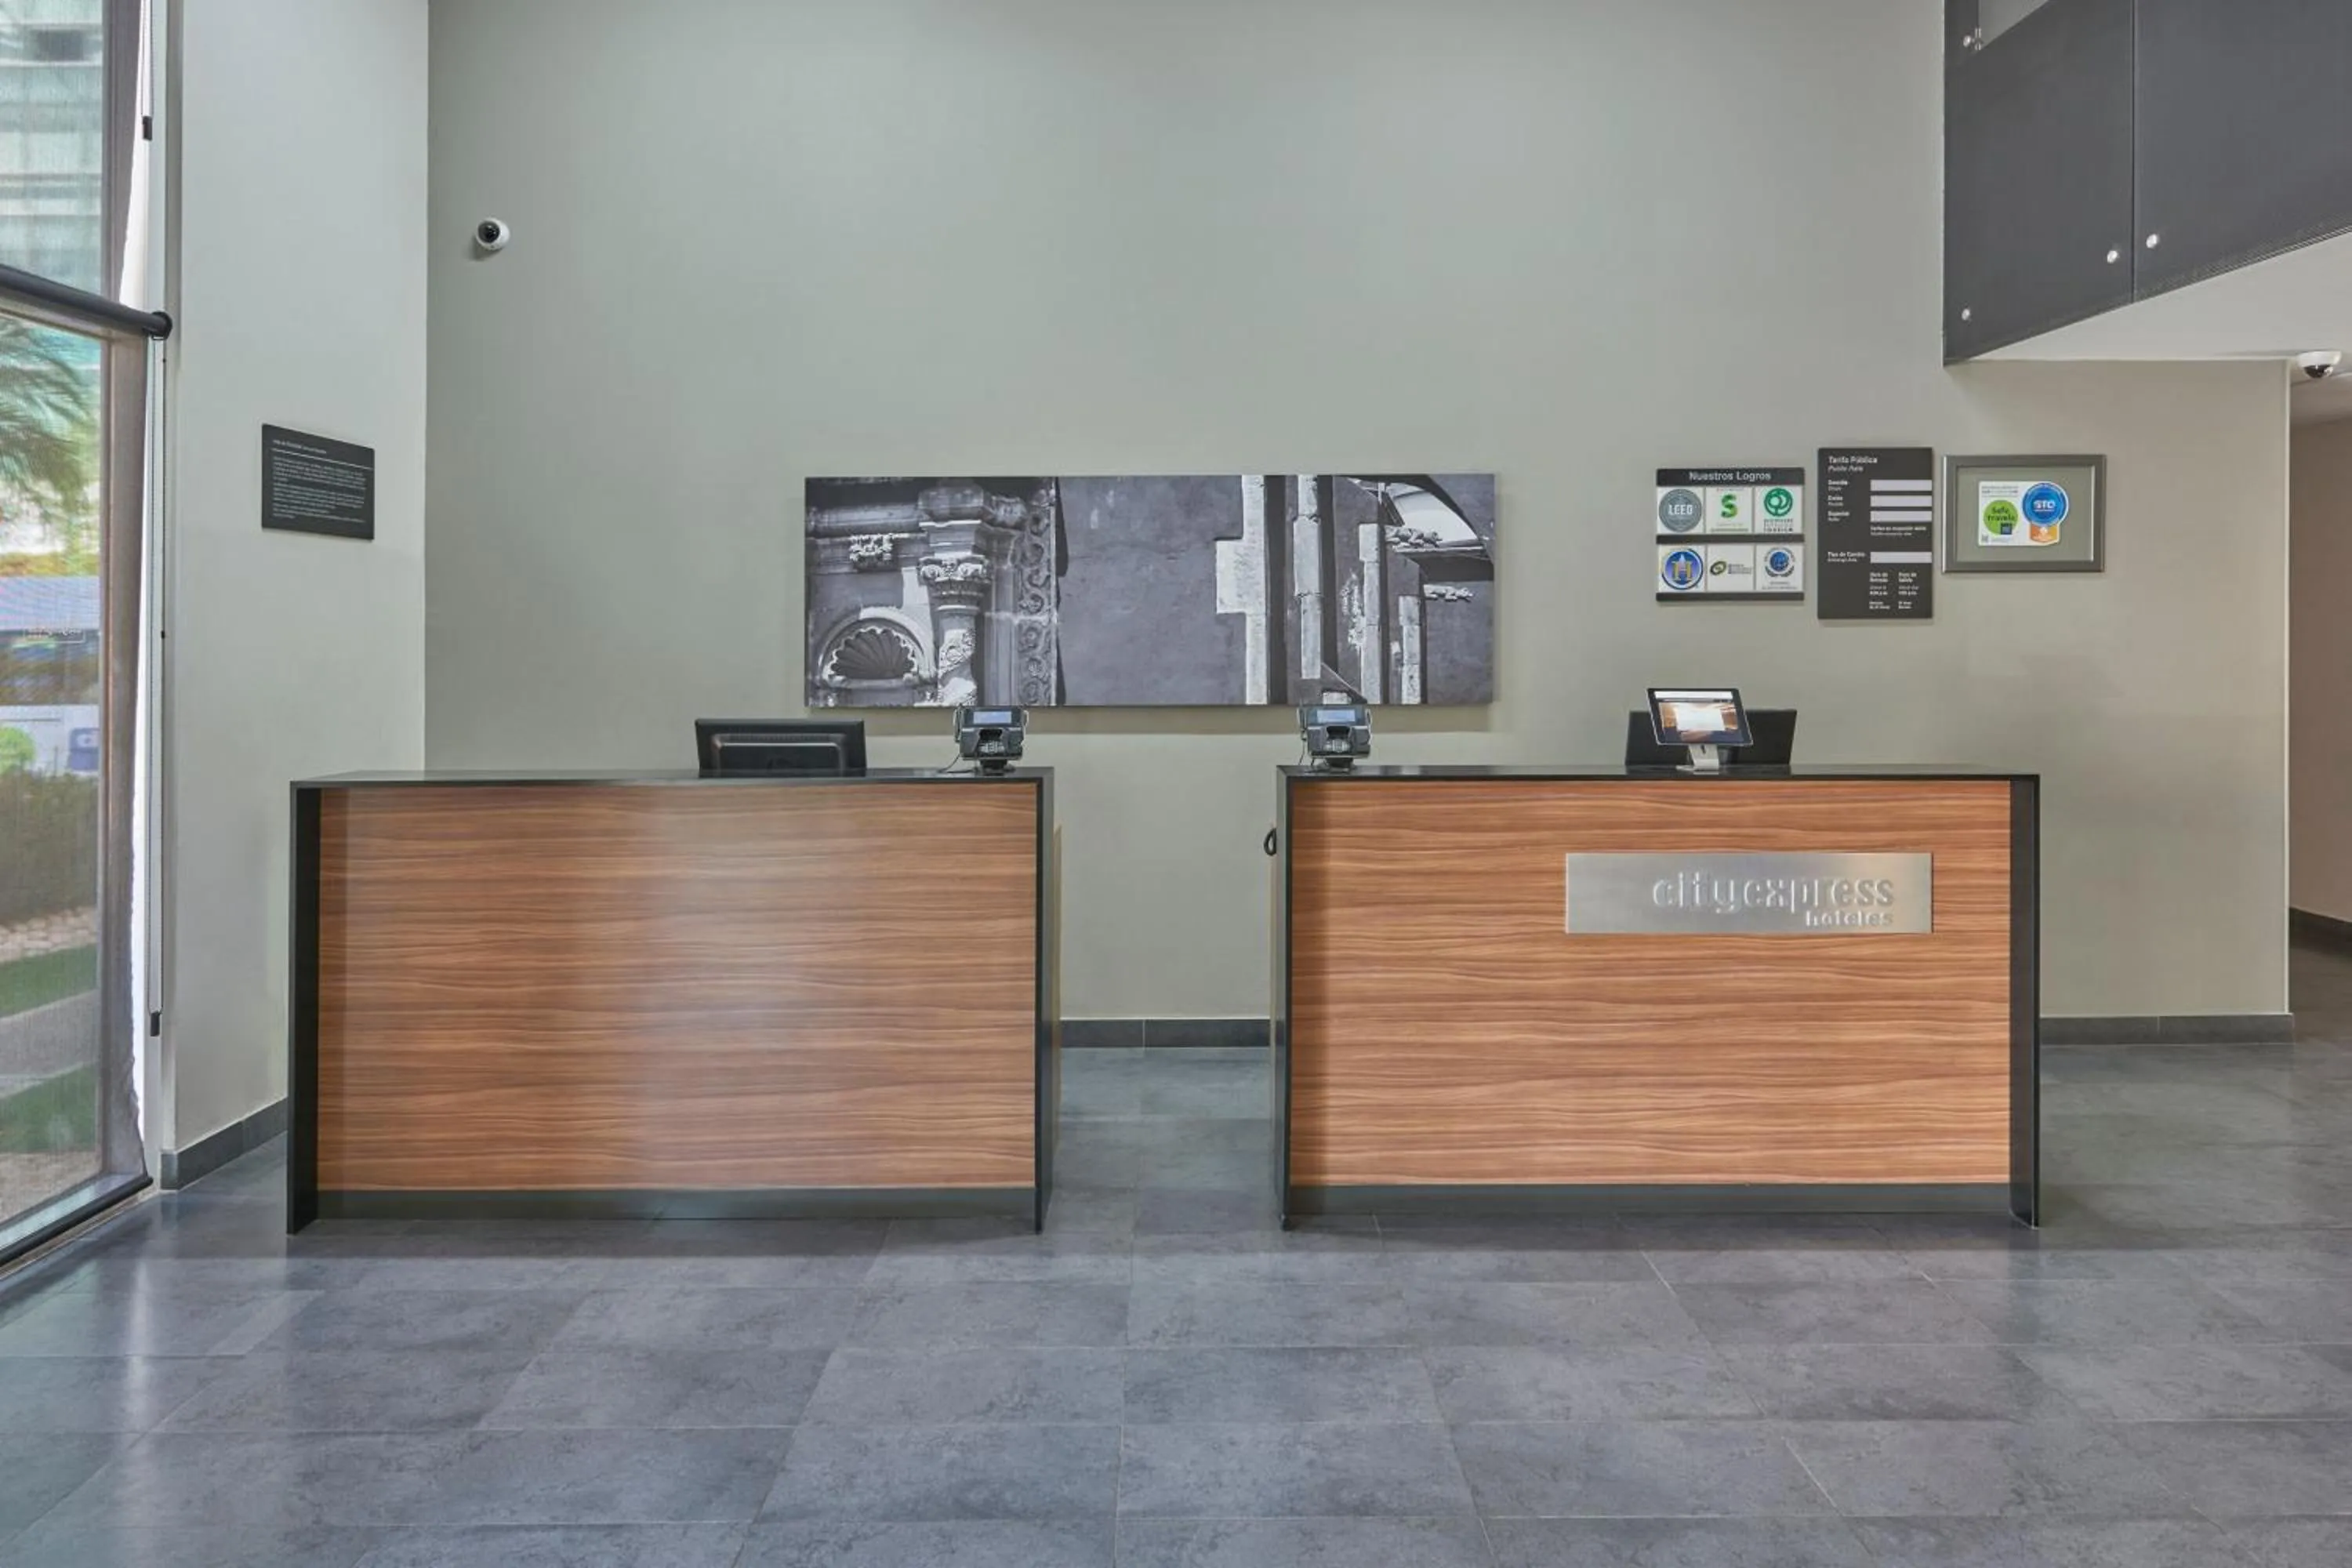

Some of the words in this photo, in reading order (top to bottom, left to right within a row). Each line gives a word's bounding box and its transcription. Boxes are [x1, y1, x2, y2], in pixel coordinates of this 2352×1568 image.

[1690, 471, 1733, 481] Nuestros
[1737, 472, 1771, 482] Logros
[1668, 504, 1693, 516] LEED
[1805, 909, 1893, 927] hoteles
